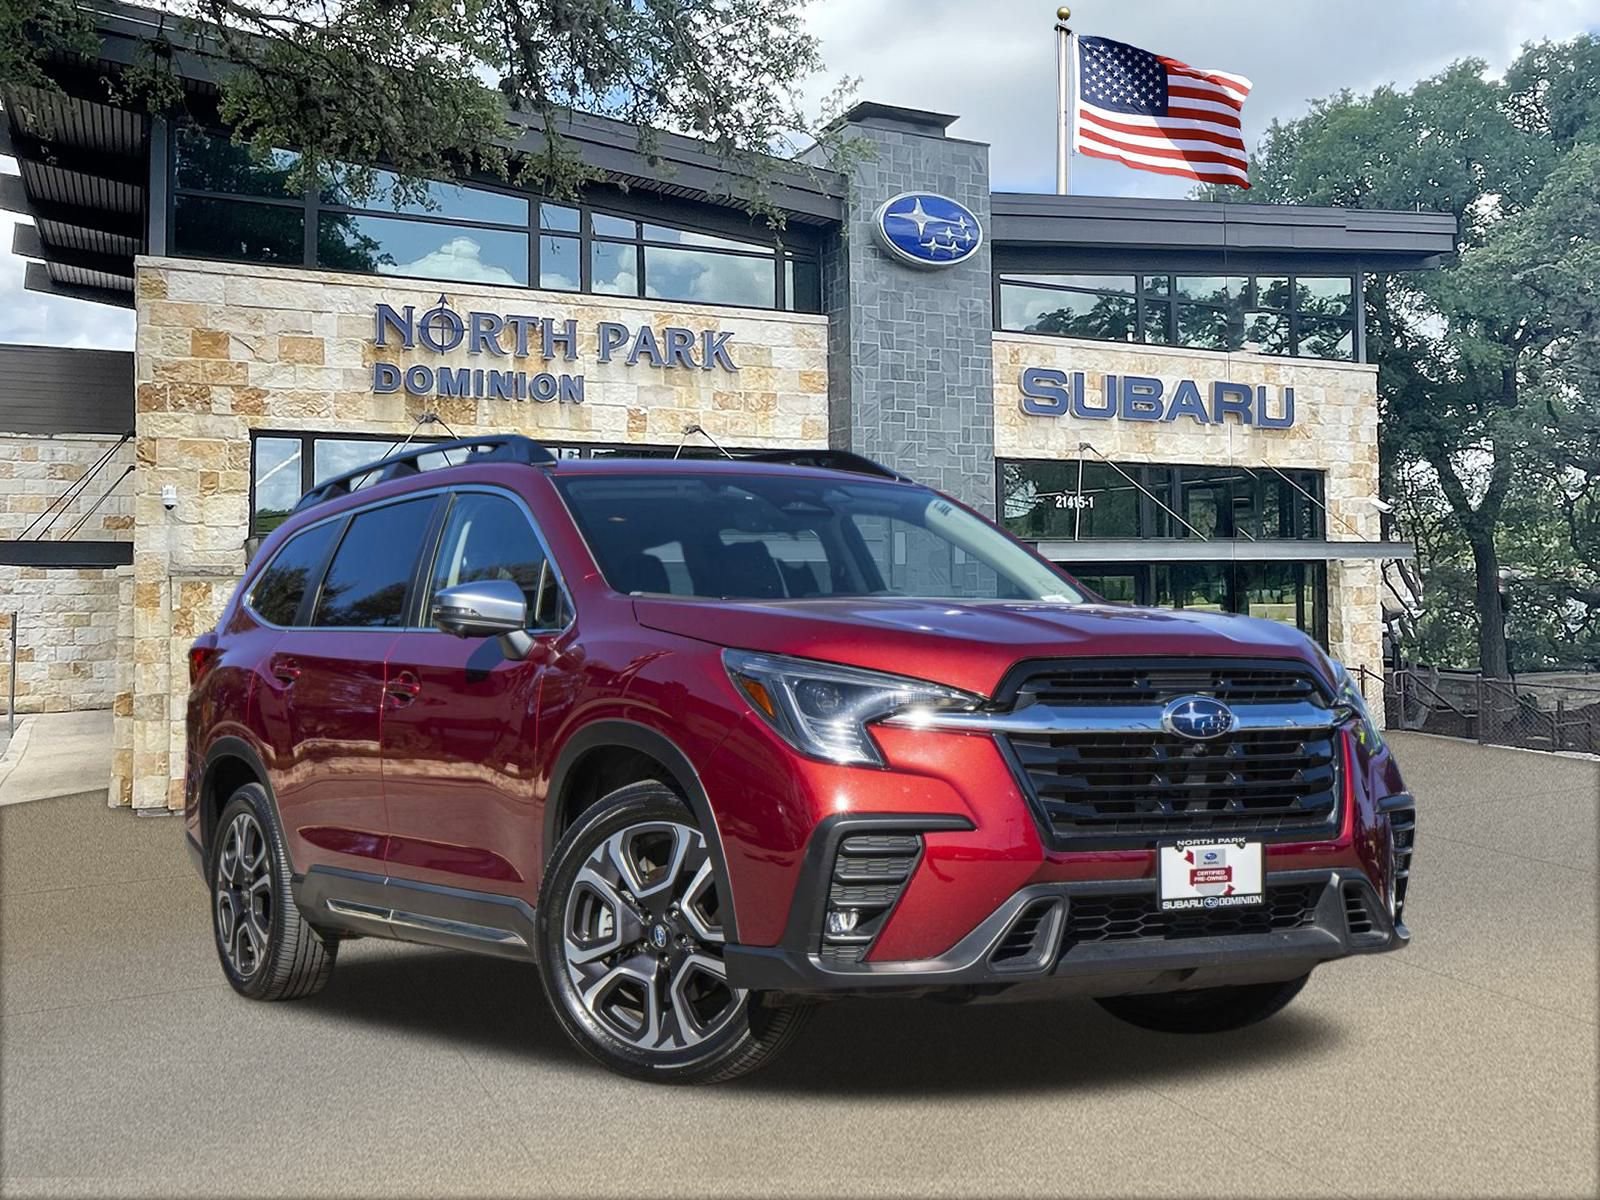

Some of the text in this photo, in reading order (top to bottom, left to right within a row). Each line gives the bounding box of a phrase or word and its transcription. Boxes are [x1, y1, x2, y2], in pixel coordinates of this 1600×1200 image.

[375, 292, 740, 372] NORTH PARK
[373, 362, 585, 404] DOMINION
[1018, 367, 1295, 430] SUBARU
[1162, 896, 1262, 909] SUBARU DOMINION
